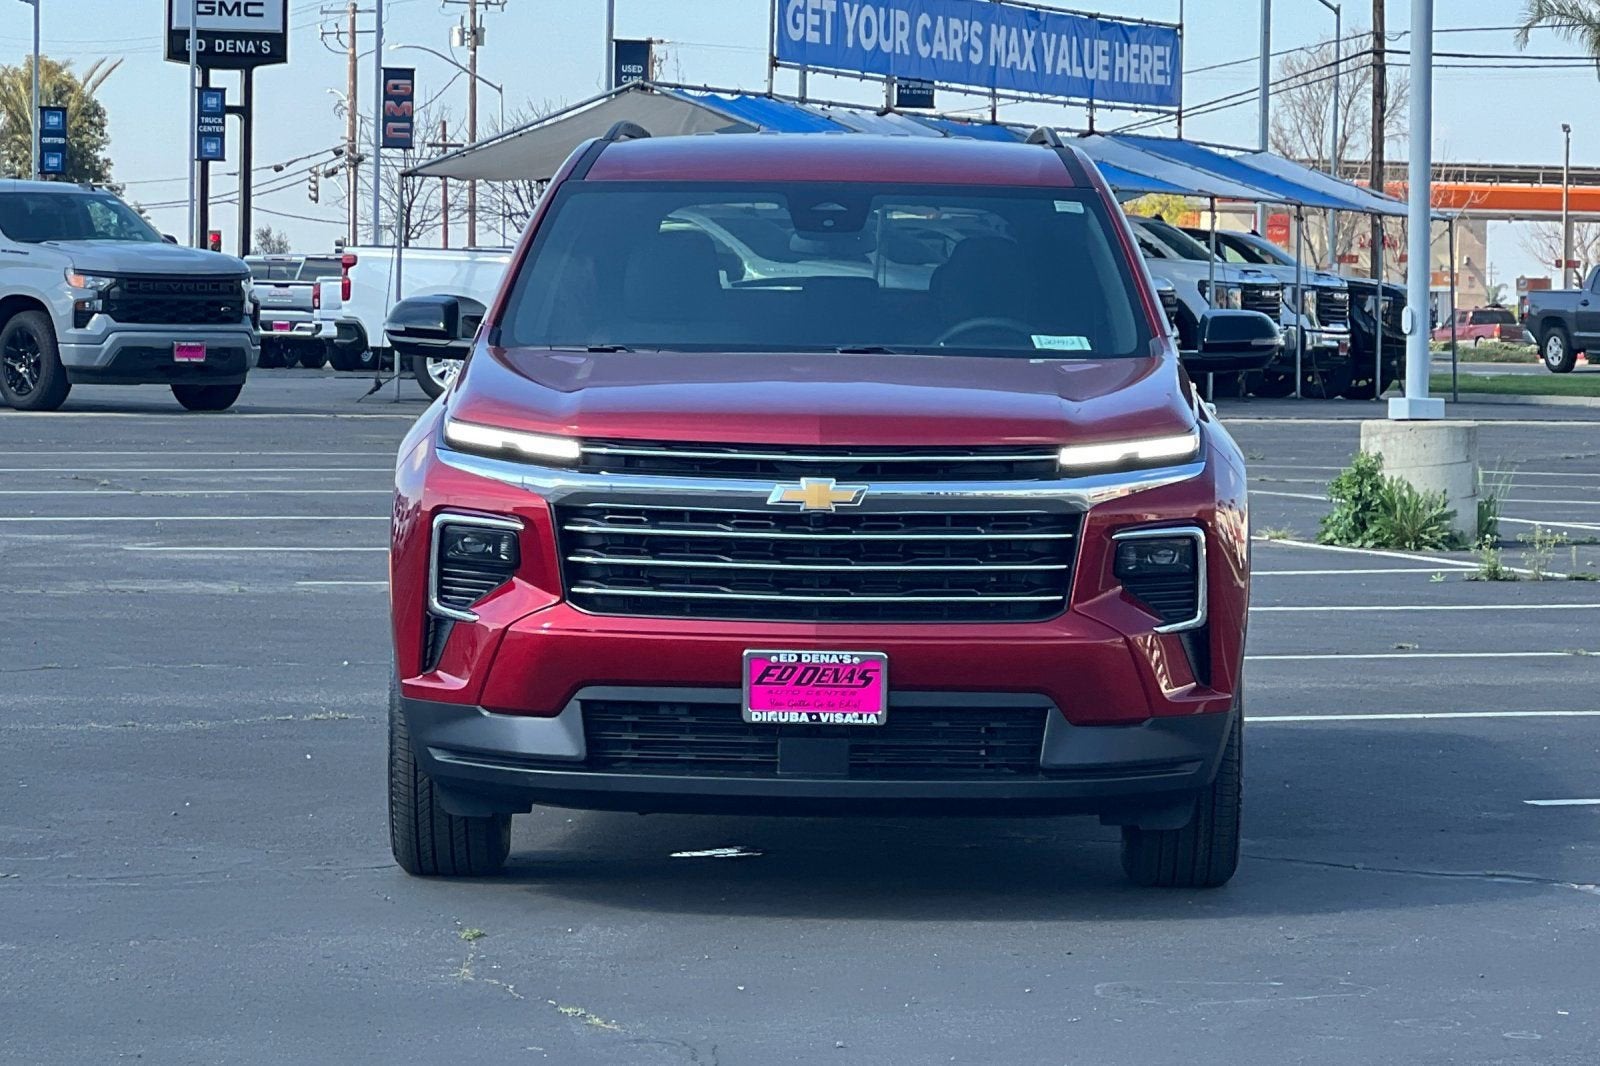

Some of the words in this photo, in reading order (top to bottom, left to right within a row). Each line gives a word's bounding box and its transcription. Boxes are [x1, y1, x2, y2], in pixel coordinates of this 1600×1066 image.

[195, 1, 264, 17] GMC
[215, 39, 271, 54] DENA'S
[786, 0, 837, 45] GET
[842, 2, 910, 55] YOUR
[915, 12, 984, 65] CAR'S
[989, 23, 1037, 73] MAX
[1040, 31, 1109, 81] VALUE
[1114, 41, 1171, 86] HERE!
[621, 64, 644, 73] USED
[200, 116, 223, 124] TRUCK
[198, 125, 225, 133] CENTER
[779, 653, 798, 663] ED
[801, 653, 852, 664] DENA'S
[753, 665, 799, 686] ED
[793, 666, 880, 689] DENA'S
[805, 689, 858, 697] CENTER
[819, 712, 878, 724] VISALIA
